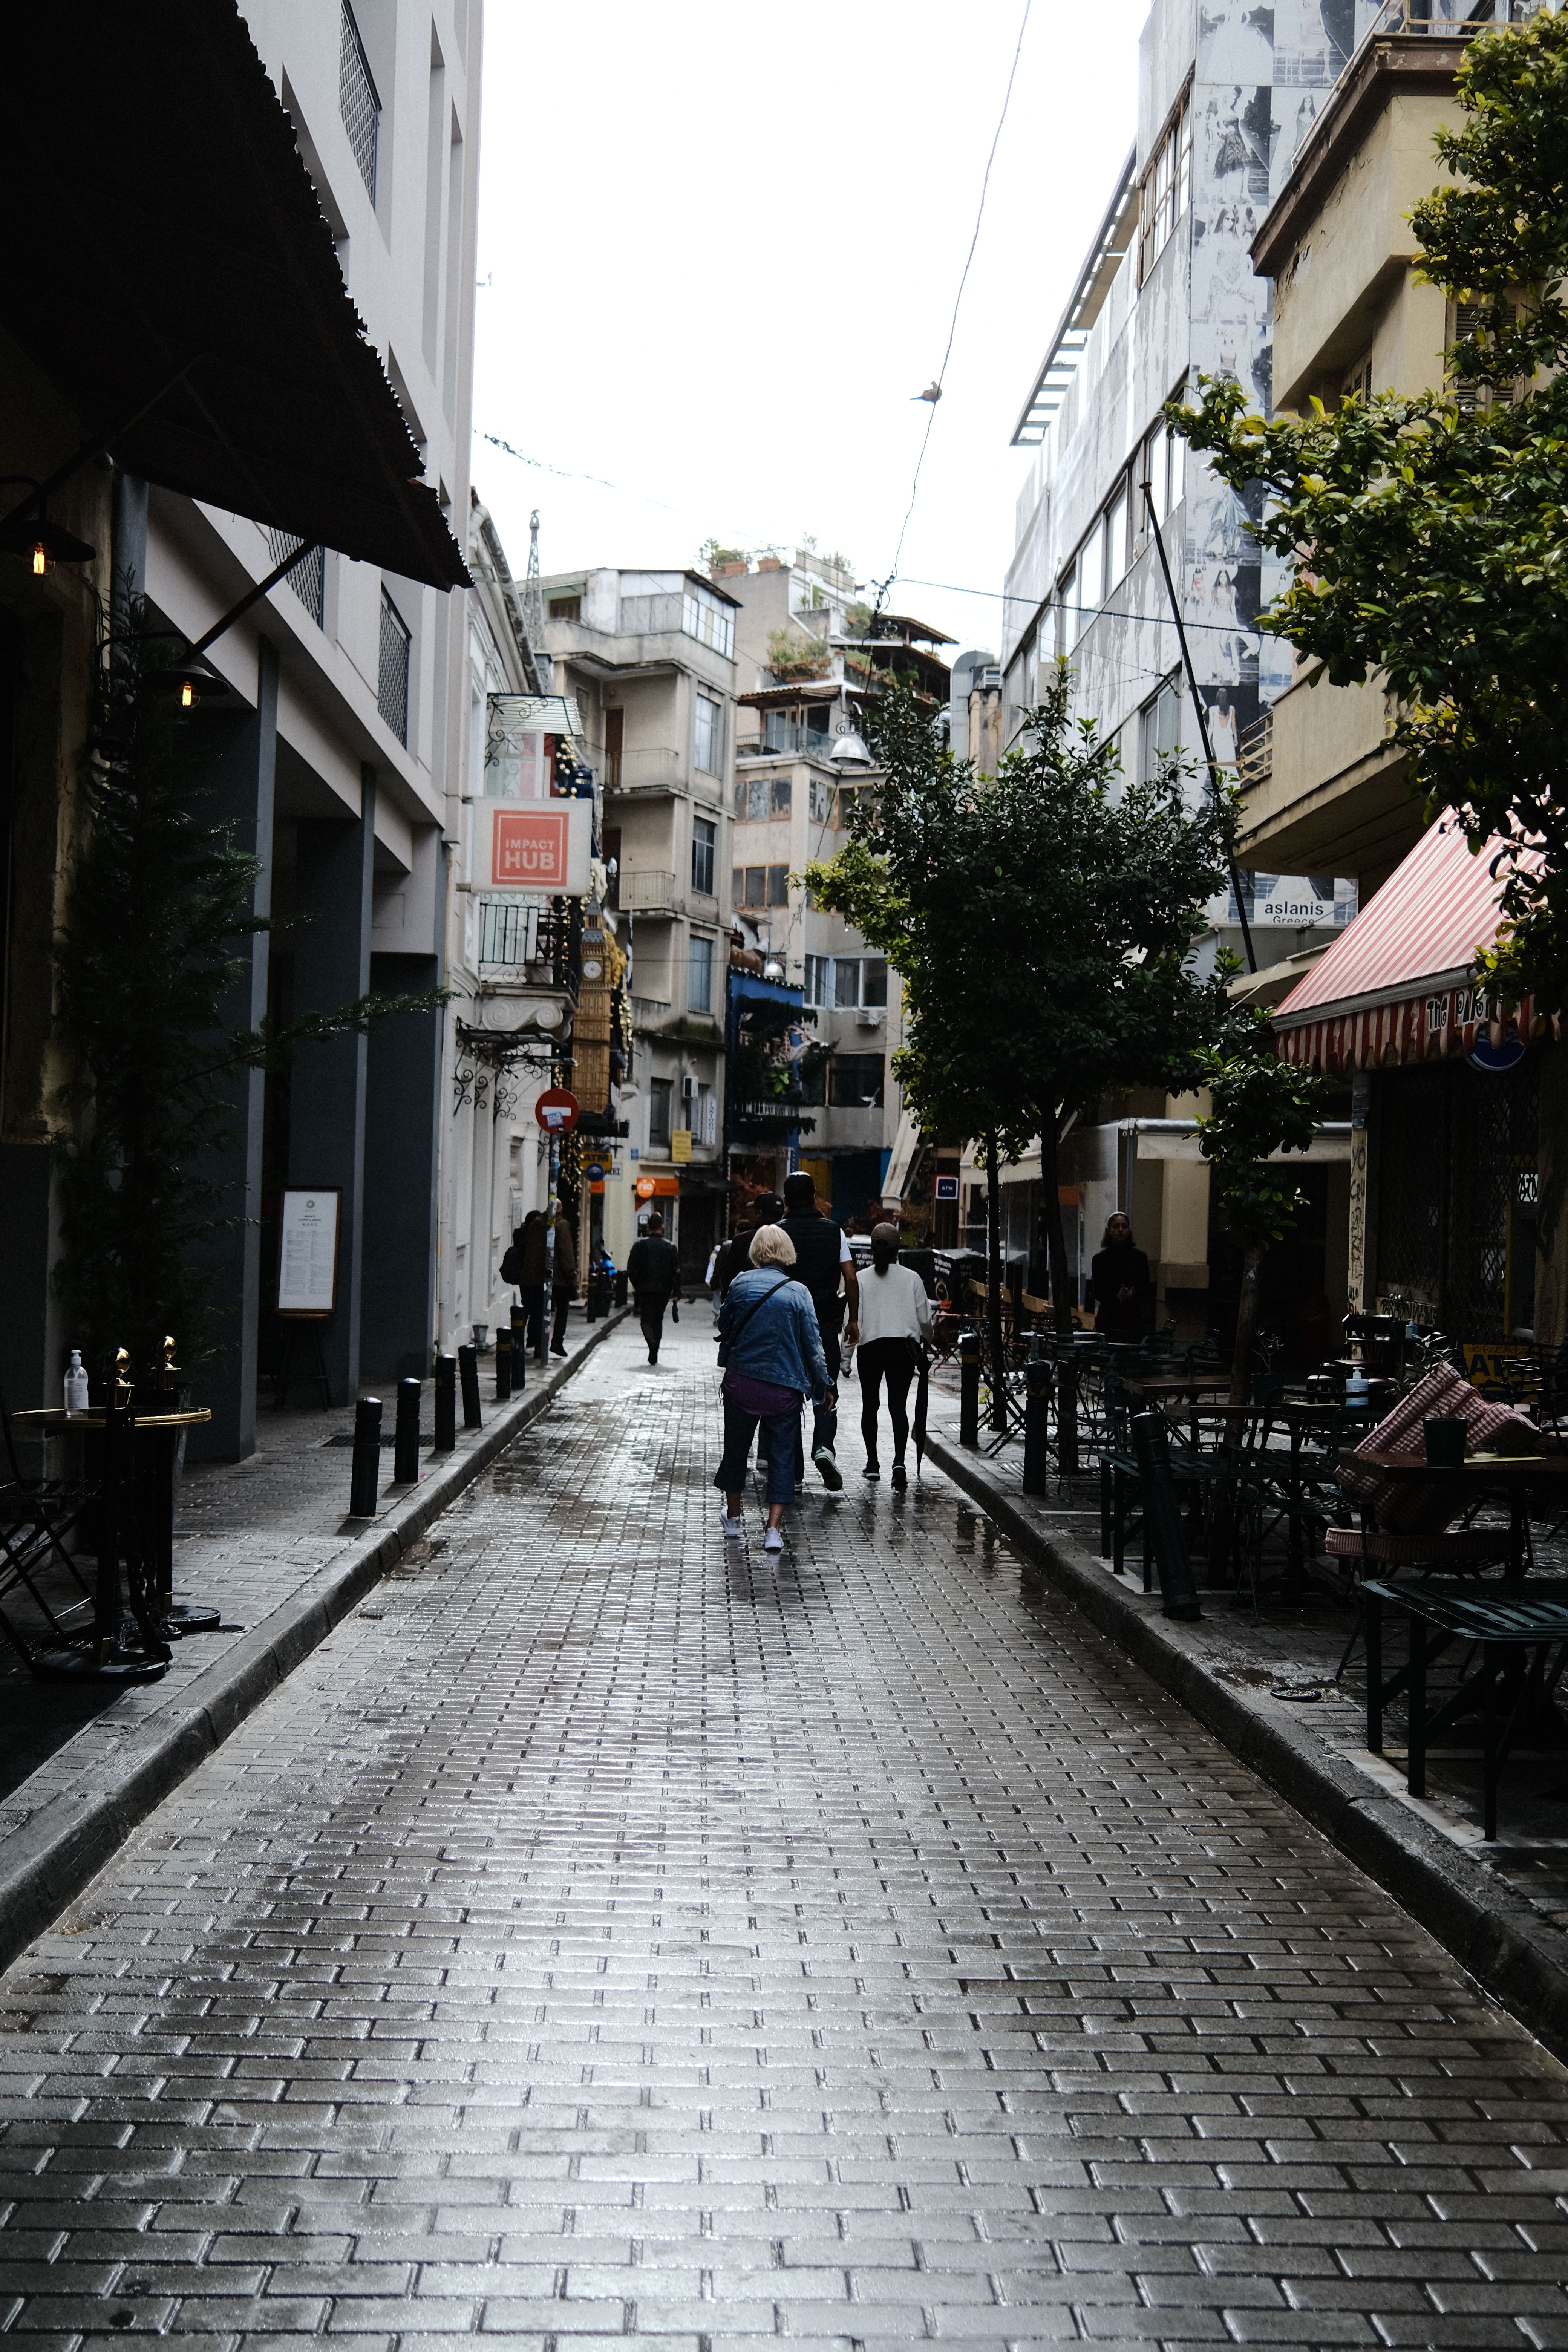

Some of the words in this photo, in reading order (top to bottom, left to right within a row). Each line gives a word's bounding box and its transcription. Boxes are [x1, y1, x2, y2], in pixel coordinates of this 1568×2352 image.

[505, 839, 555, 850] IMPACT
[505, 850, 555, 870] HUB
[1265, 901, 1323, 915] aslanis
[638, 1179, 654, 1190] ria
